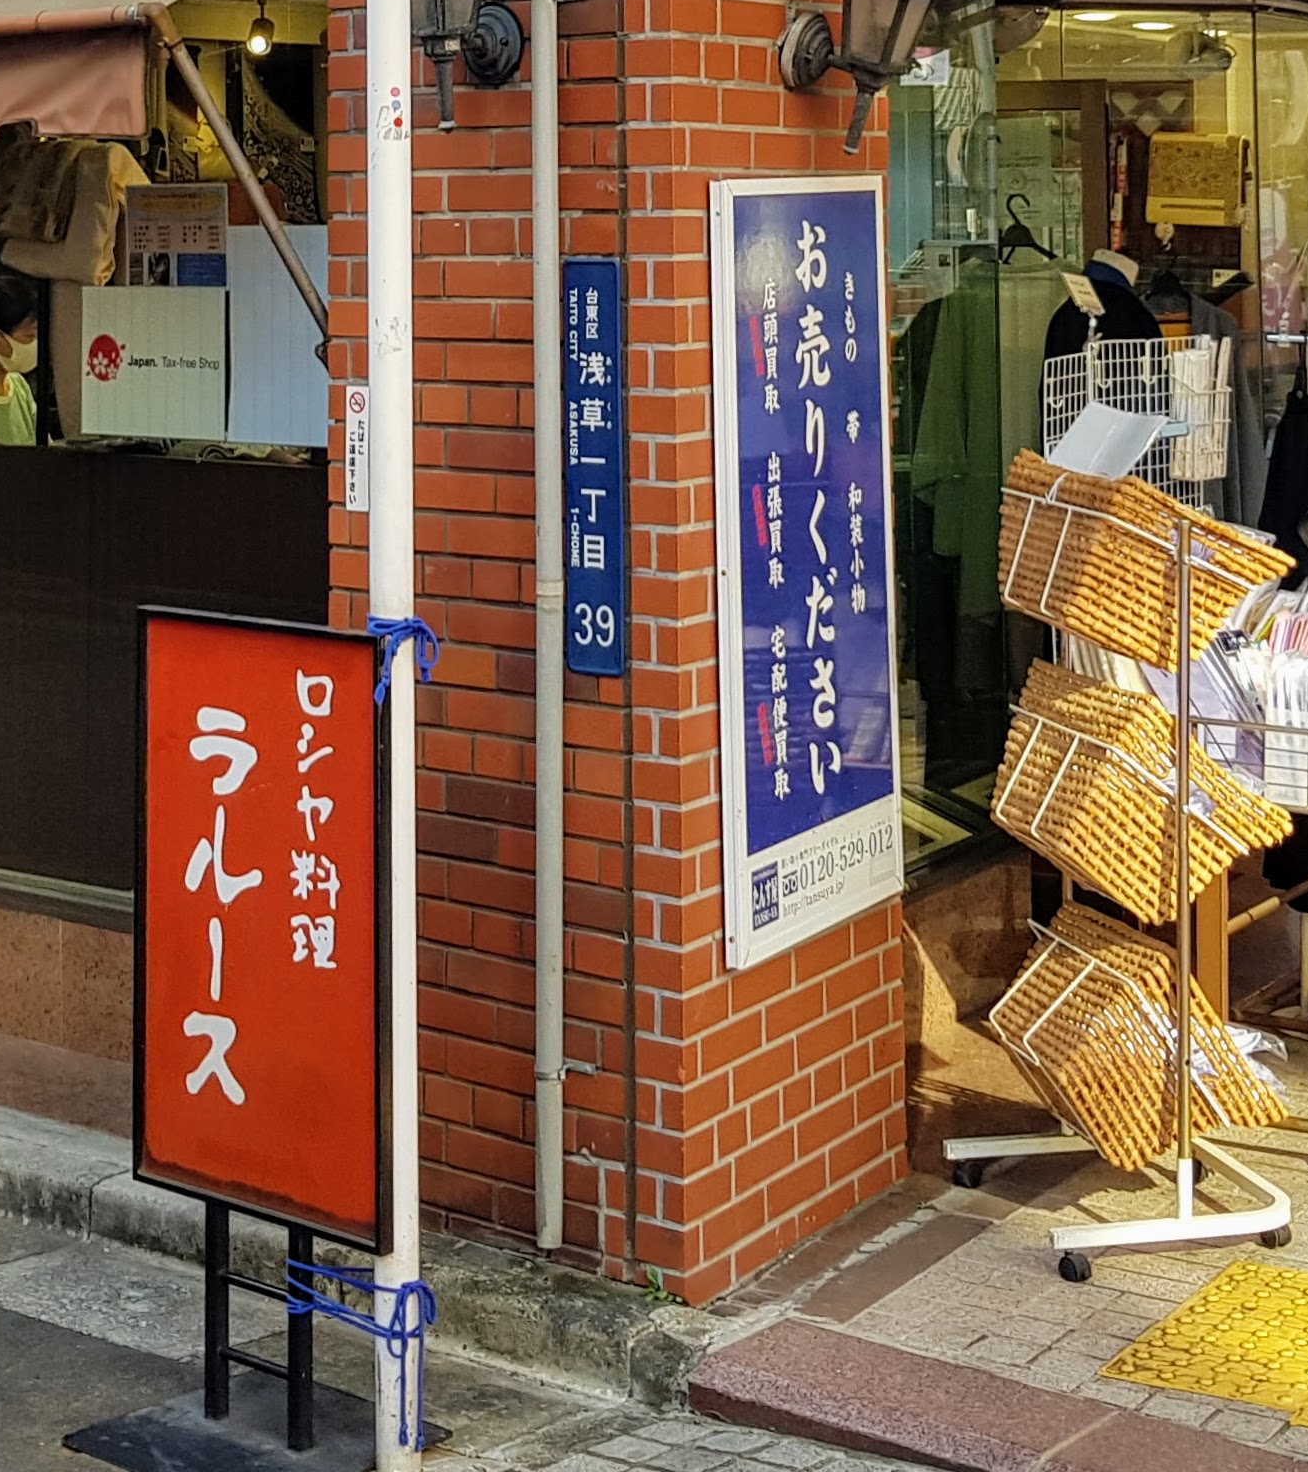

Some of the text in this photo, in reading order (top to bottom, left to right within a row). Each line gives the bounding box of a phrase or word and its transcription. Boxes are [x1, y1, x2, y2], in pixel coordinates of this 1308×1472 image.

[162, 356, 196, 369] Tax-free
[199, 357, 220, 370] Shop
[569, 287, 581, 569] TAITO CITY ASAKUSA 1-CHOME
[579, 286, 607, 570] 台東区 浅草一丁目
[795, 220, 842, 797] お売りください
[844, 271, 867, 615] きもの 帯 和装小物
[574, 602, 616, 648] 39
[763, 278, 791, 801] 店頭買取 出張買取 宅配便買取
[182, 704, 264, 1106] ラルース
[291, 668, 341, 970] ロシヤ料理
[800, 824, 893, 890] 0120-529-012
